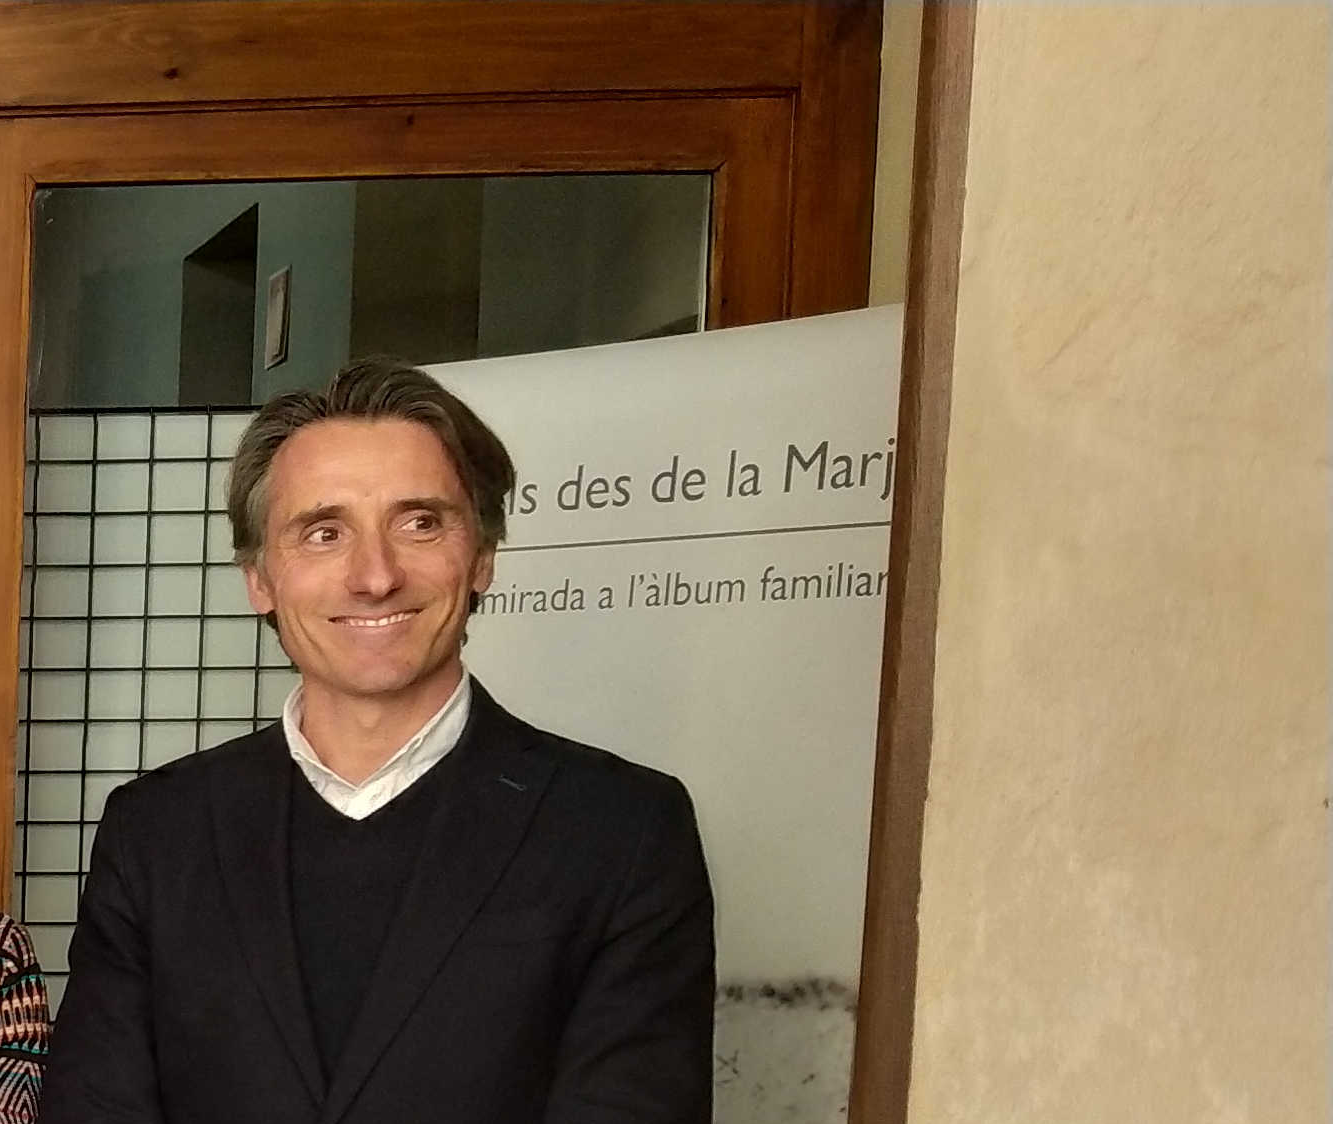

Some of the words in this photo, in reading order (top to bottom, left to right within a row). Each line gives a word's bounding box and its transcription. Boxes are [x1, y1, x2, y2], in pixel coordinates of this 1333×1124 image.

[557, 465, 632, 511] des
[651, 455, 706, 503] de
[726, 449, 761, 498] la
[783, 438, 896, 501] Marj
[480, 578, 585, 616] mirada
[598, 587, 614, 610] a
[627, 572, 745, 608] l'àlbum
[760, 562, 890, 601] familiar
